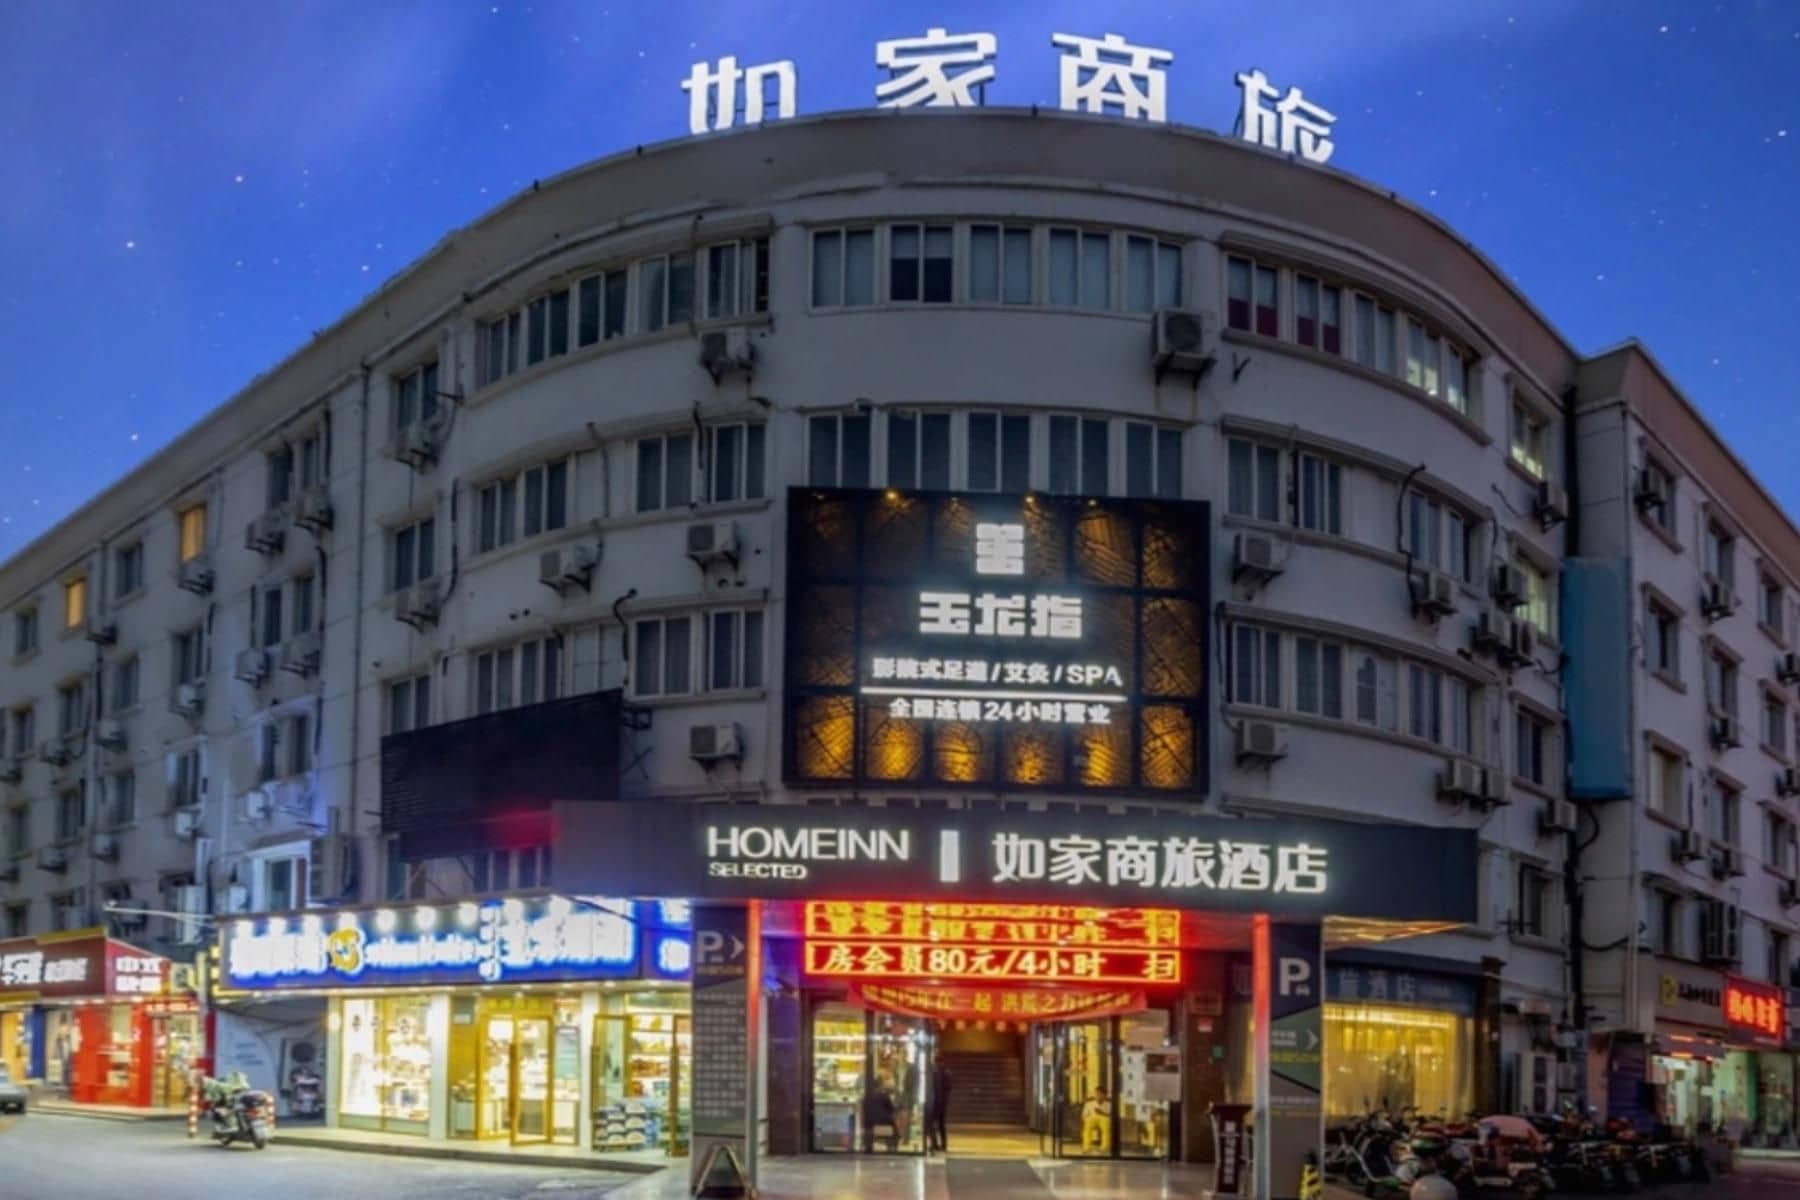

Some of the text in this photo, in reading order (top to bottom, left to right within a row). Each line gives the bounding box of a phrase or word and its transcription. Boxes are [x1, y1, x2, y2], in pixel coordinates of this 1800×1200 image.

[682, 28, 1338, 164] 如家商旅
[707, 826, 909, 861] HOMEINN
[992, 832, 1328, 894] 如家商旅酒店
[708, 862, 807, 880] SELECTED
